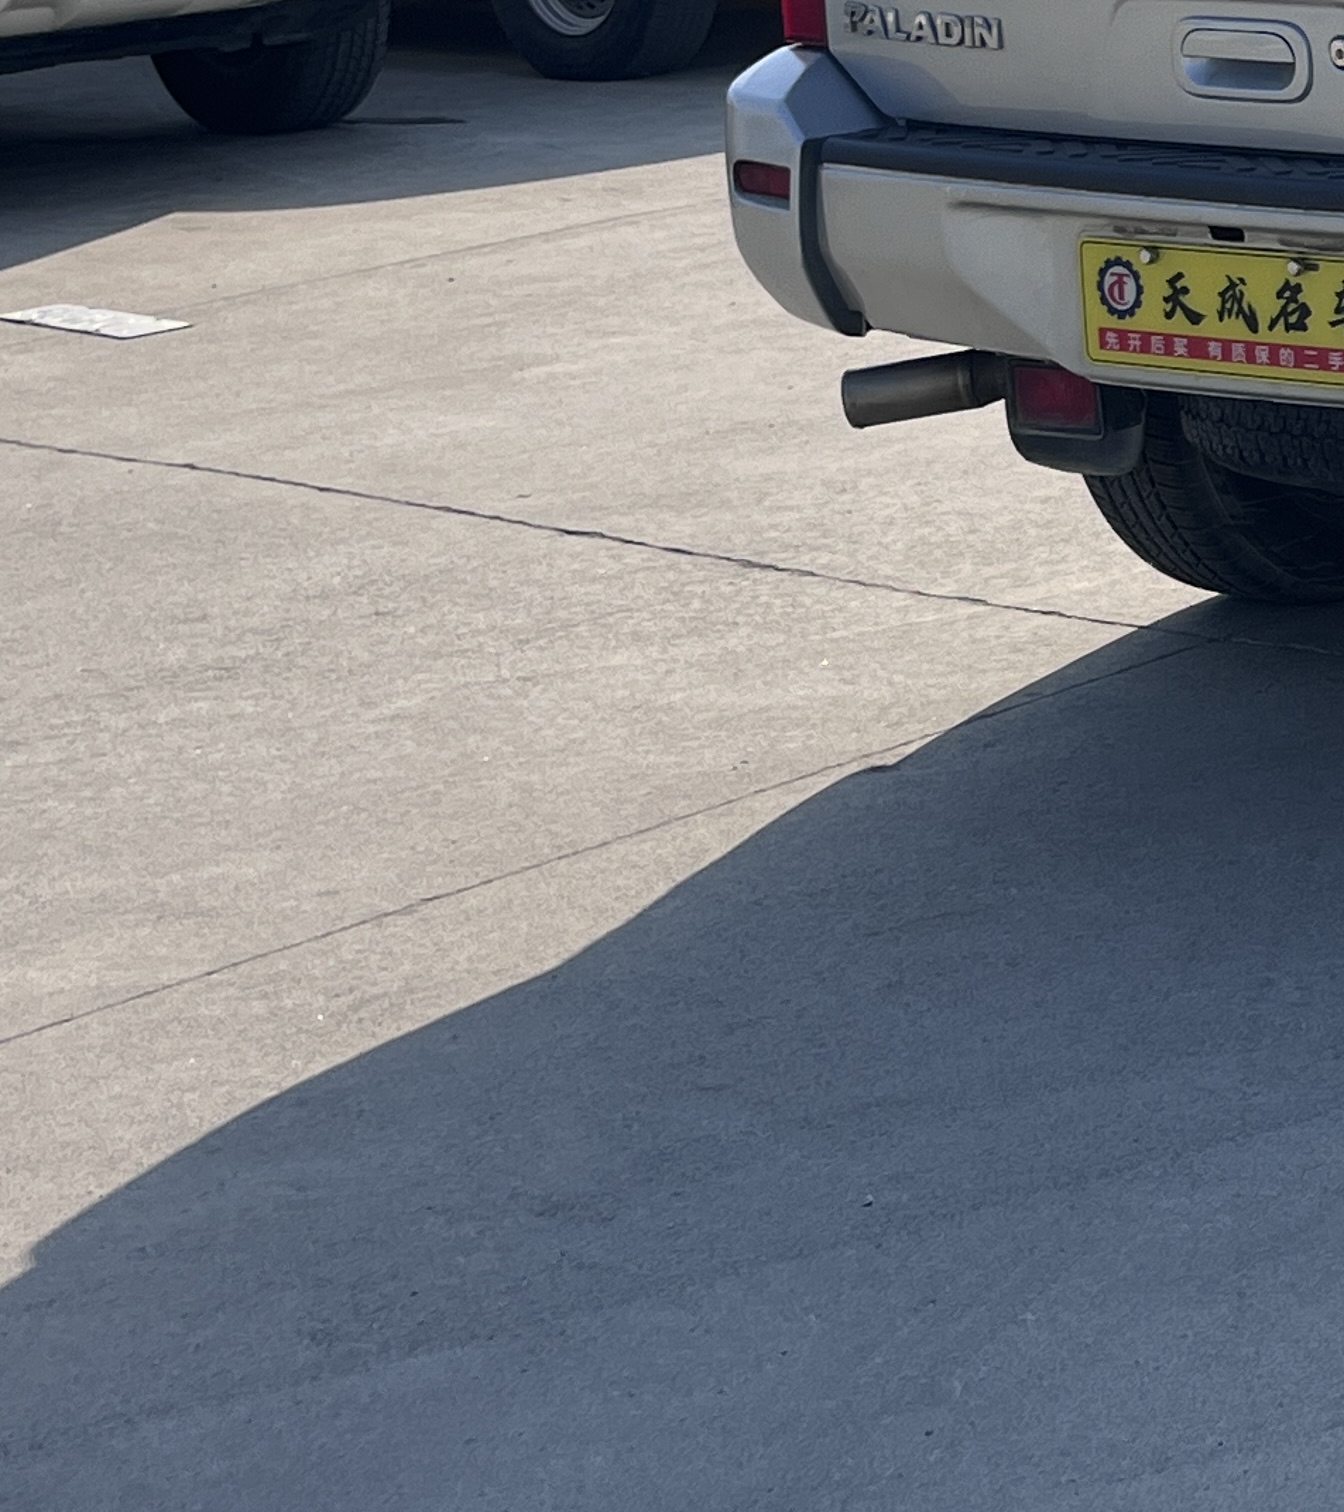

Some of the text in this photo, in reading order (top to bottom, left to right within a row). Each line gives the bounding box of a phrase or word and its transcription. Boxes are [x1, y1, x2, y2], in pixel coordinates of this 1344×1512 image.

[844, 0, 1004, 51] PALADIN
[1104, 330, 1189, 358] 先开后买
